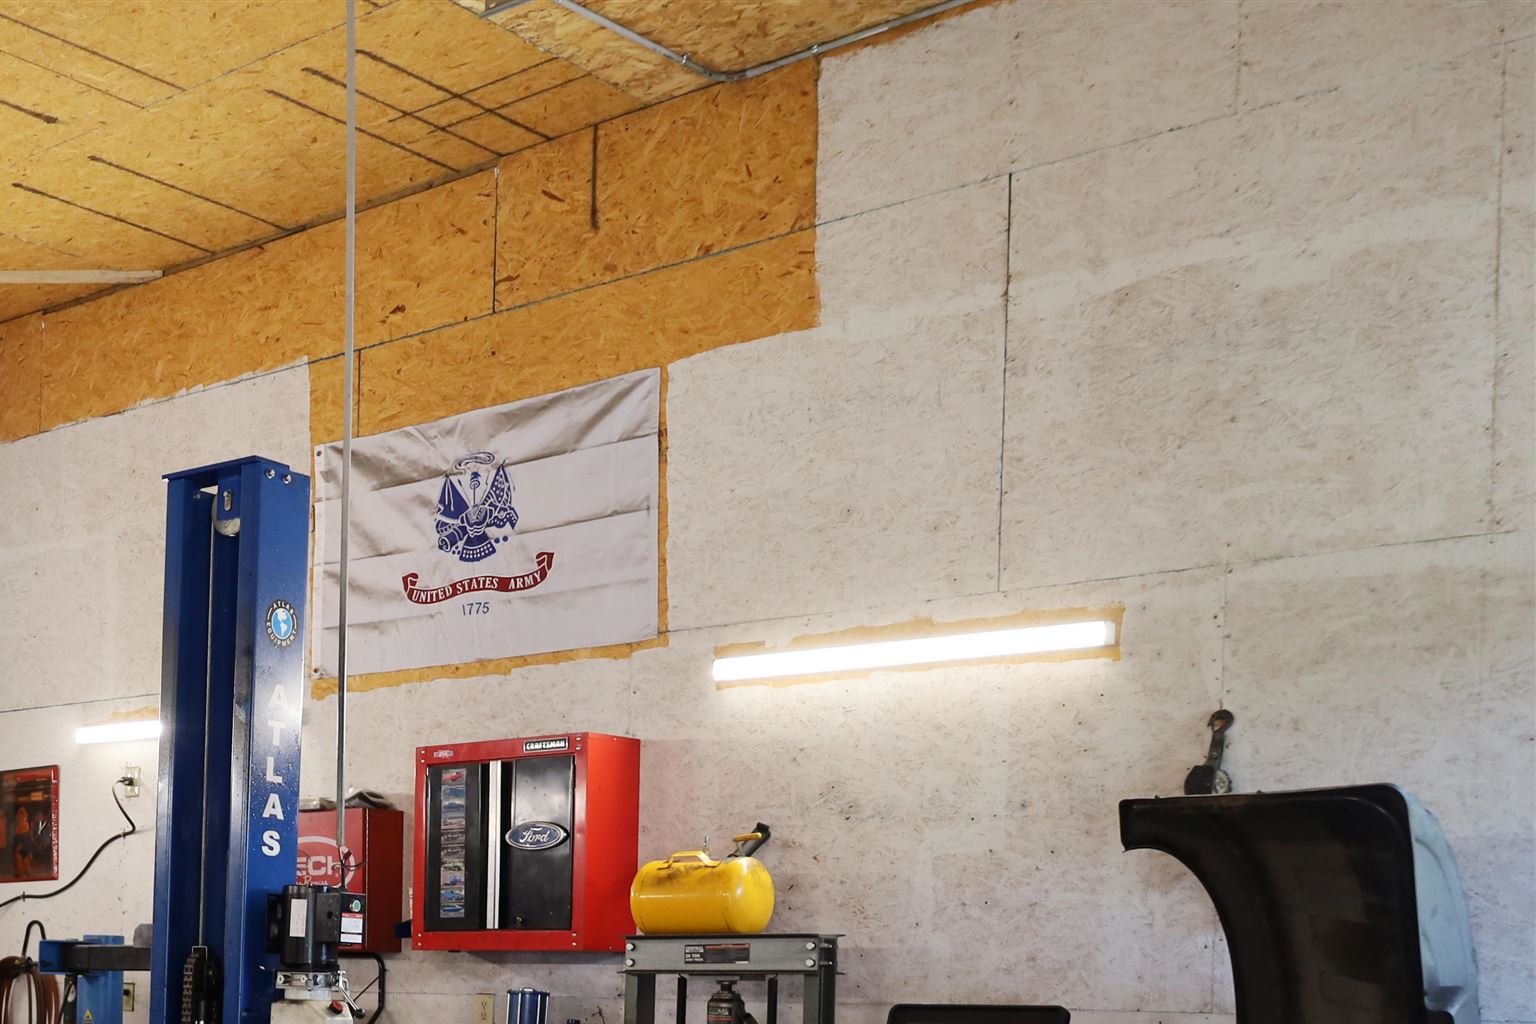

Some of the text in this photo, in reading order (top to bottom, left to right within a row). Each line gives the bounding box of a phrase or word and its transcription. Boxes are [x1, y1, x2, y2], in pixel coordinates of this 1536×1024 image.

[412, 570, 543, 603] UNITED STATES ARMY
[462, 602, 490, 616] 1775
[526, 740, 565, 751] CRAFTSMAN
[261, 684, 289, 858] ATLAS
[519, 827, 550, 843] Ford
